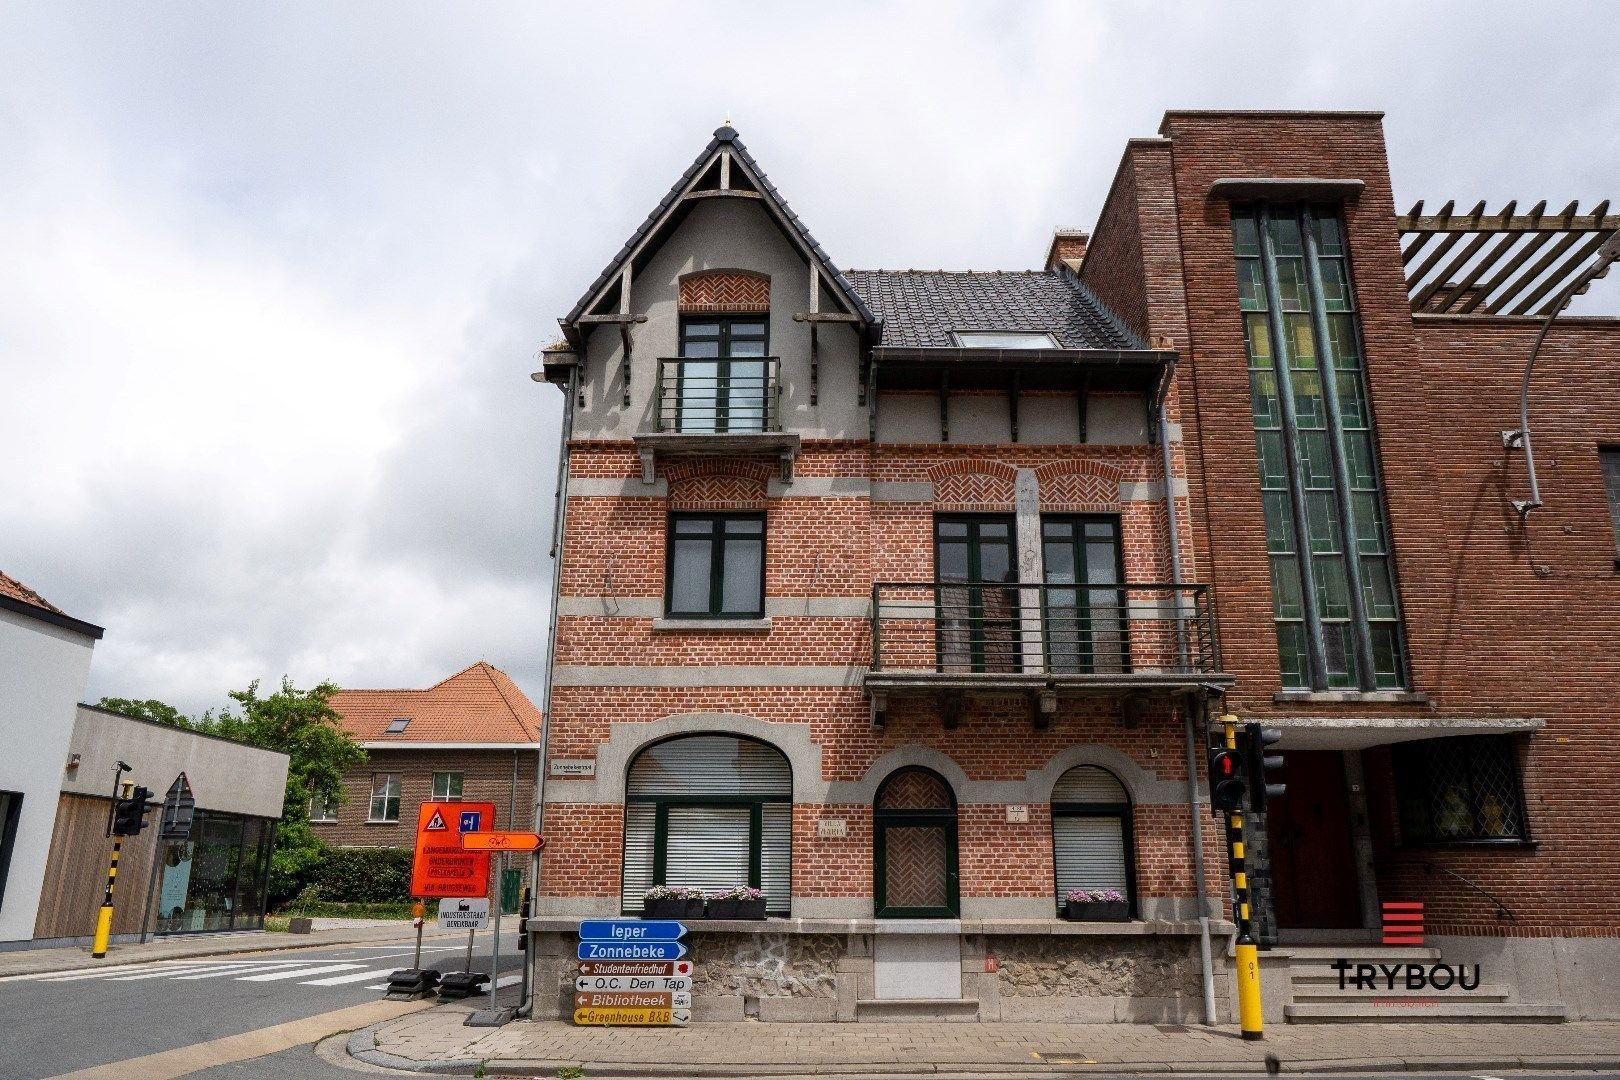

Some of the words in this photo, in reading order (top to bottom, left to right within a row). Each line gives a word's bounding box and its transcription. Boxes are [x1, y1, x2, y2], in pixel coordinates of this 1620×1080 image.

[424, 883, 435, 892] VIA
[440, 911, 487, 919] INDUSTRIESTRAAT
[611, 924, 647, 940] Ieper
[589, 944, 665, 958] Zonnebeke
[593, 963, 668, 974] Studentenfriedhof
[595, 978, 622, 989] O.C.
[629, 978, 655, 989] Den
[663, 978, 685, 991] Tap
[591, 994, 666, 1006] Bibliotheek
[587, 1011, 644, 1023] Greenhouse
[648, 1011, 670, 1022] B&B
